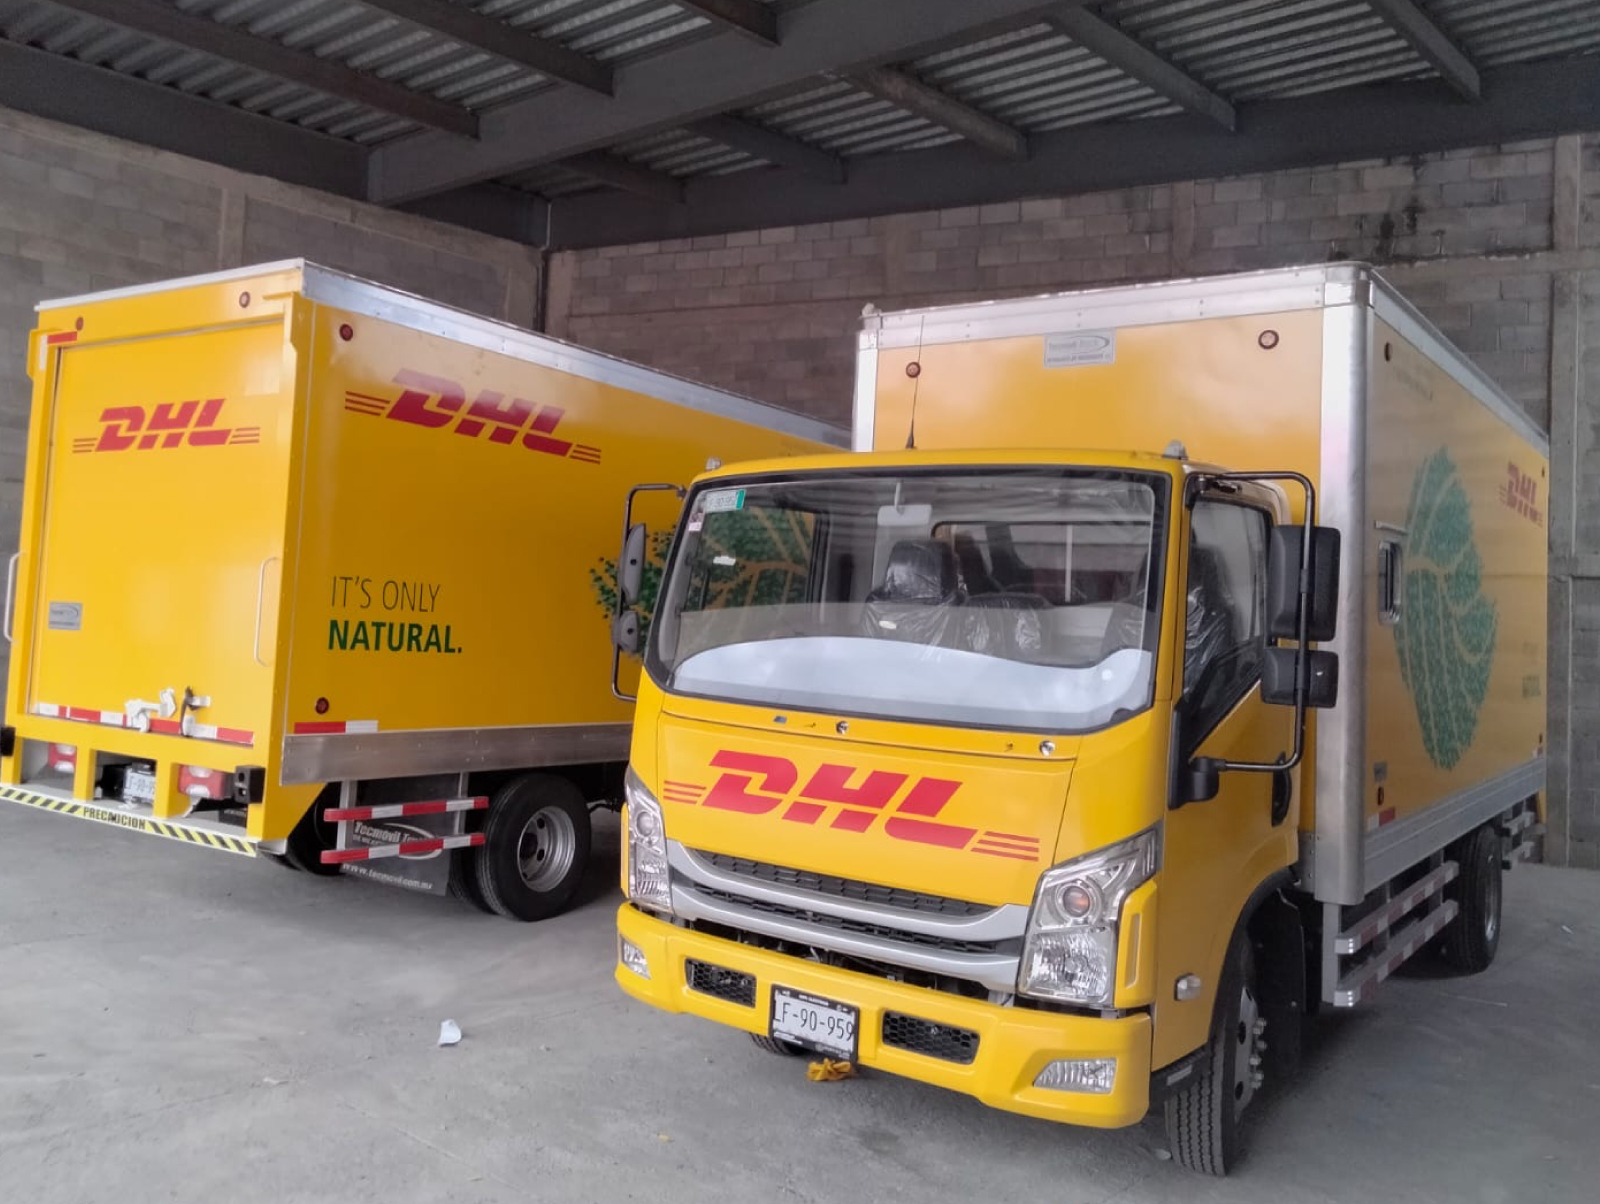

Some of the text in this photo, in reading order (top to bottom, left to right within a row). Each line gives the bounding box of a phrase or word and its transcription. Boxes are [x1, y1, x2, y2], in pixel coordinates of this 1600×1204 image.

[95, 398, 232, 452] DHL
[386, 367, 574, 458] DHL
[1506, 462, 1538, 524] DHL
[331, 575, 441, 613] IT'S ONLY
[328, 619, 464, 654] NATURAL.
[701, 749, 978, 850] DHL
